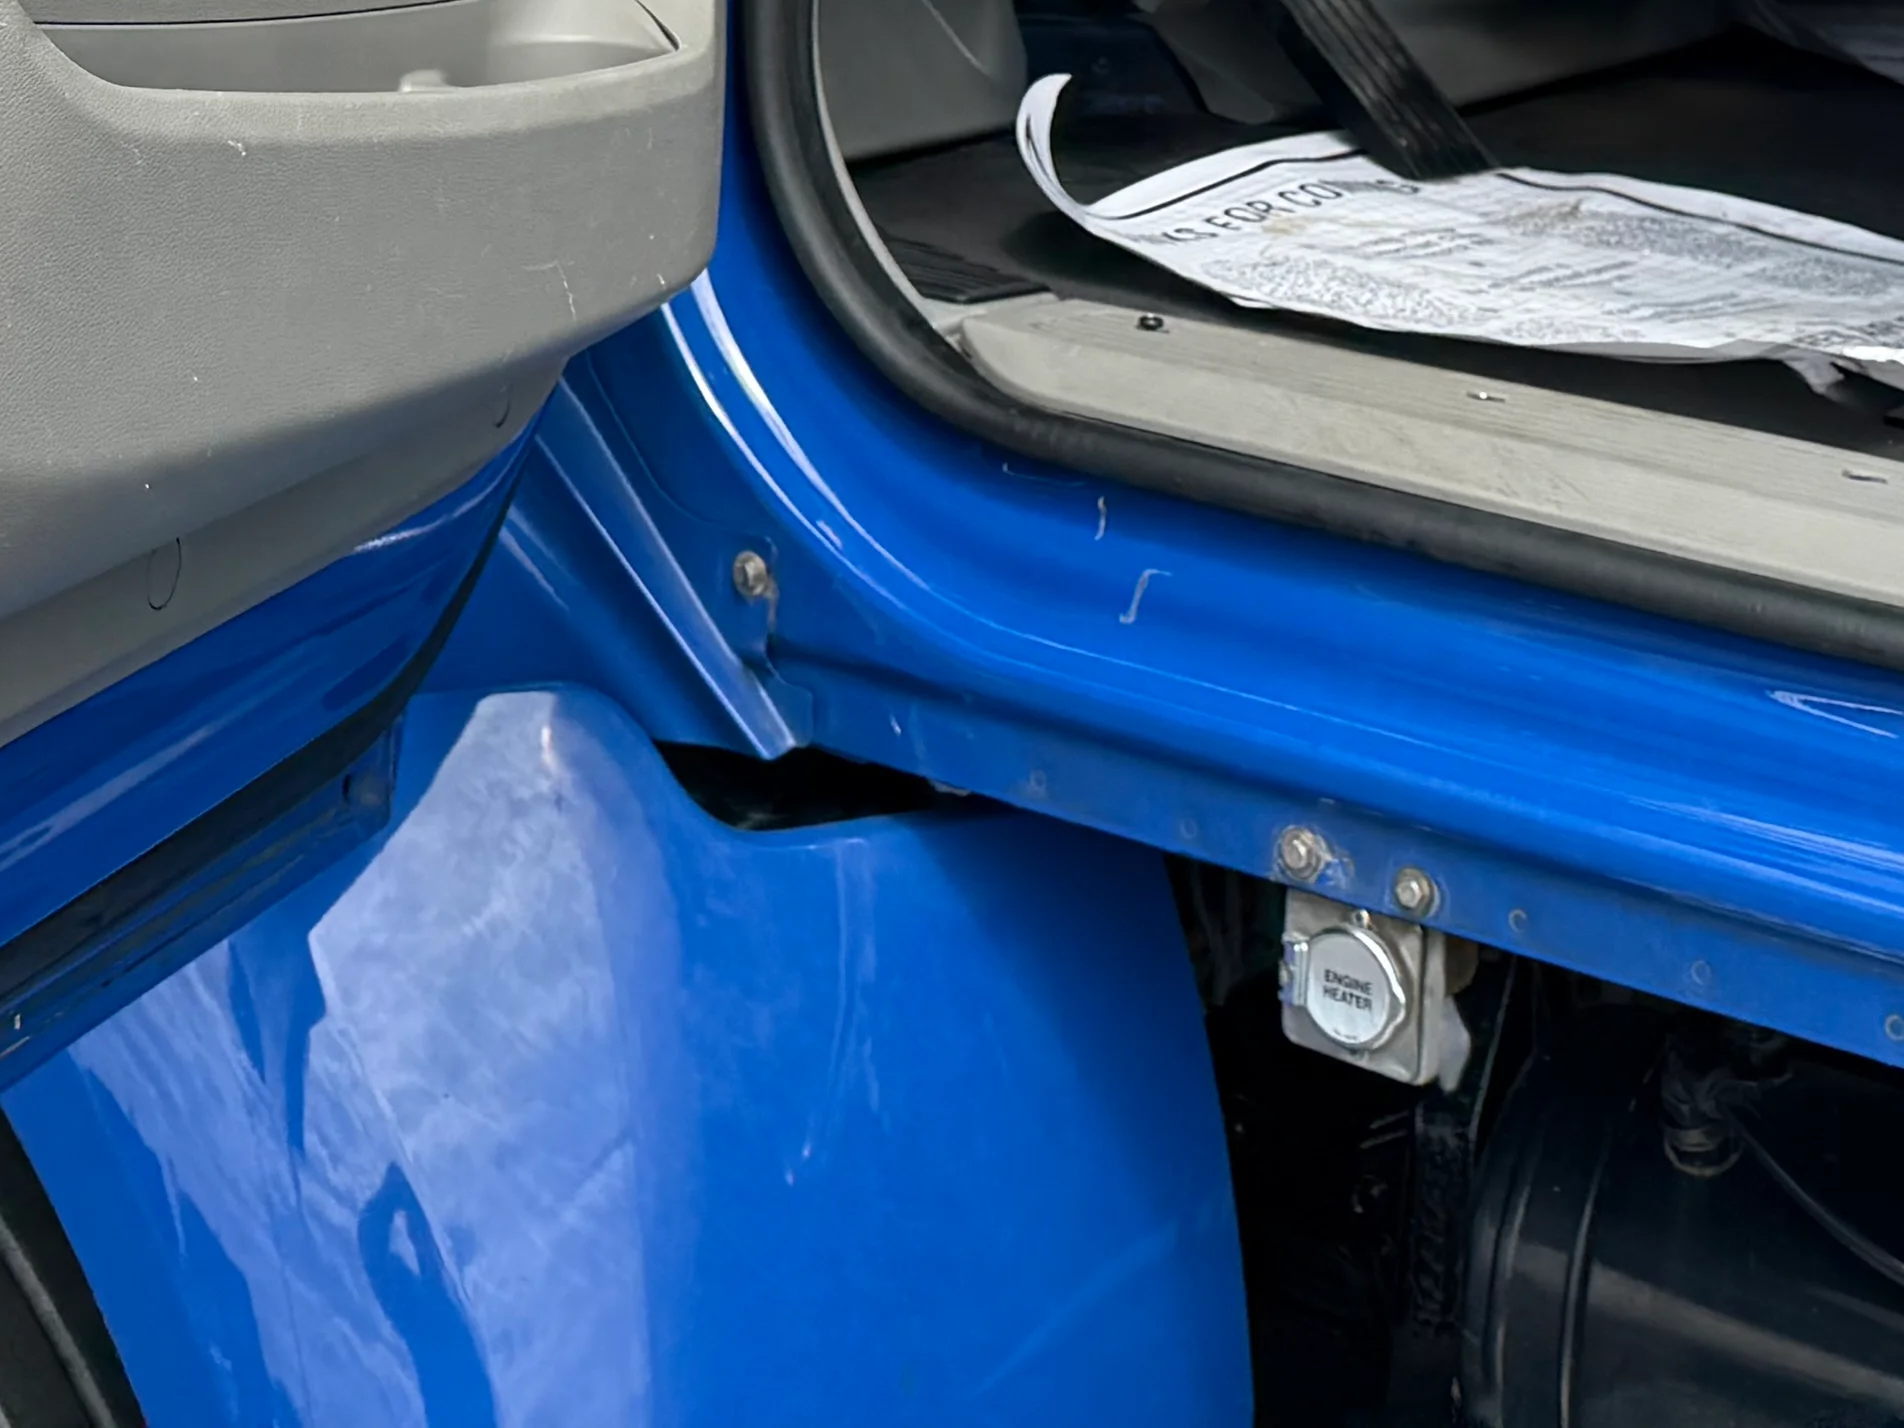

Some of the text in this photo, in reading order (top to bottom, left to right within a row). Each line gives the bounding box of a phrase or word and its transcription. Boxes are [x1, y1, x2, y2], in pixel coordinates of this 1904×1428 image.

[1204, 199, 1296, 232] FOR
[1324, 968, 1372, 996] ENGINE
[1323, 985, 1372, 1011] HEATER
